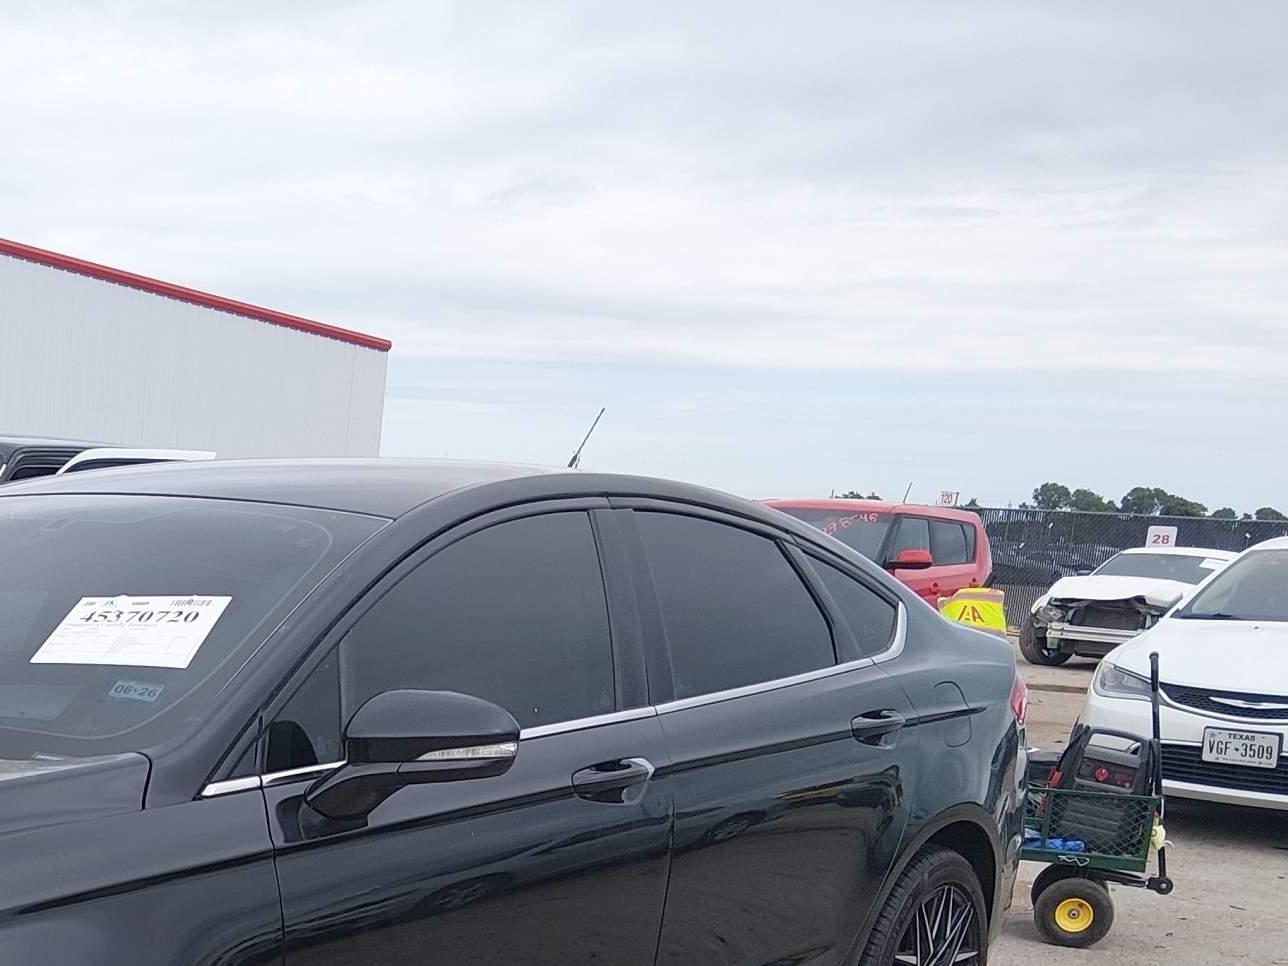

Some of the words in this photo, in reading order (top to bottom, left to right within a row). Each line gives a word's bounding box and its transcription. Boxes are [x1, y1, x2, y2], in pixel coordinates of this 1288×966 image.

[1152, 534, 1170, 545] 28
[79, 610, 200, 623] 45370720
[1227, 733, 1256, 742] TEXAS
